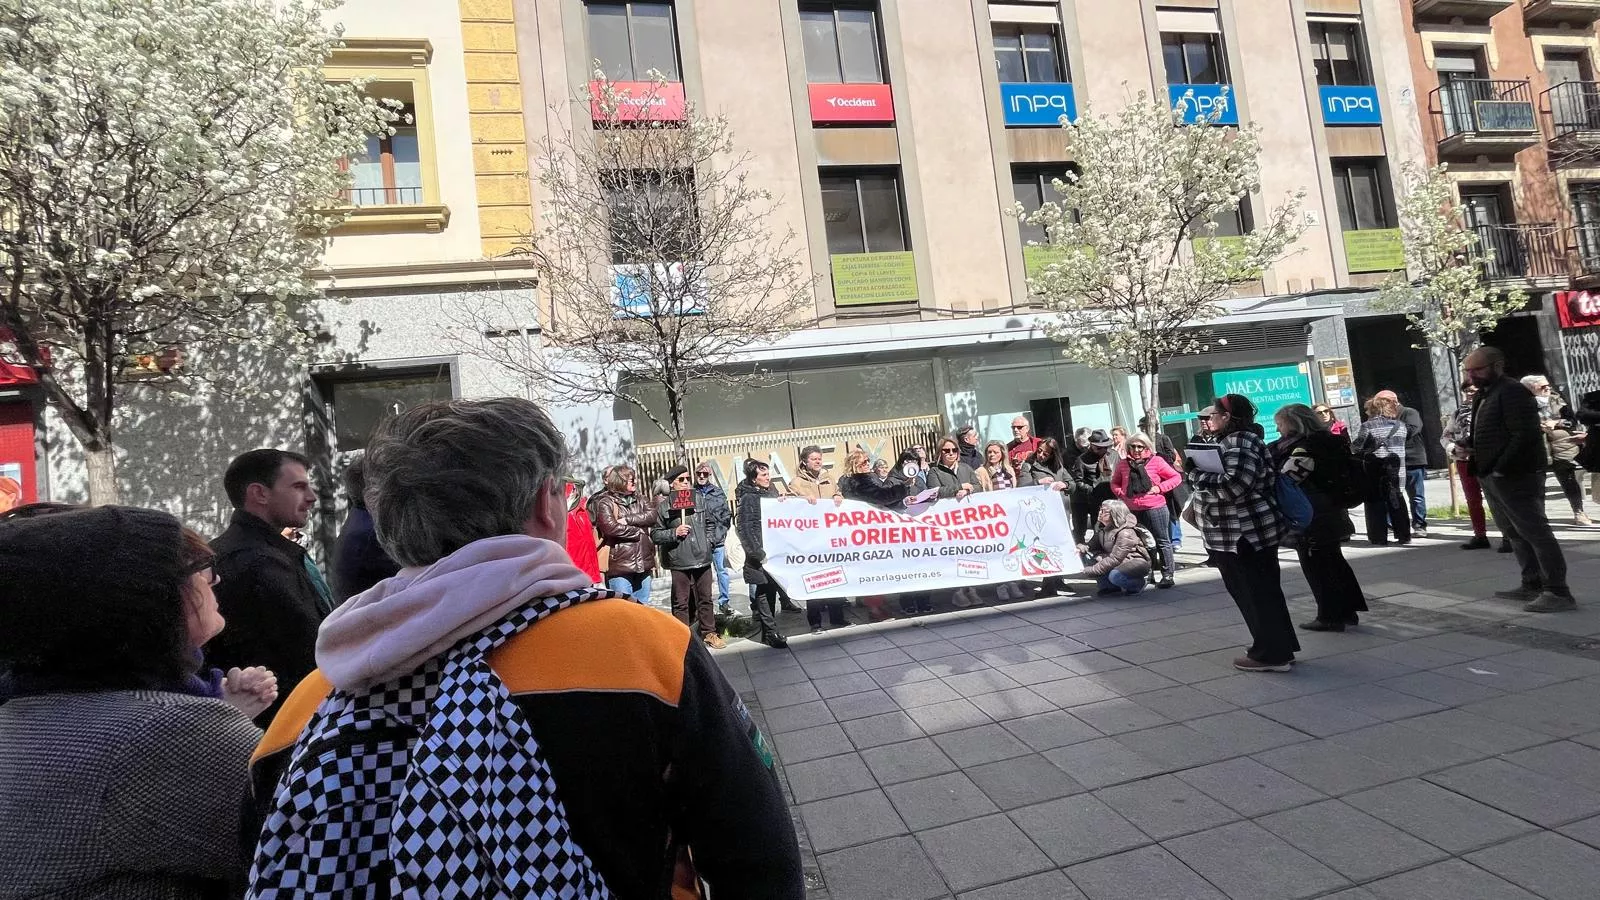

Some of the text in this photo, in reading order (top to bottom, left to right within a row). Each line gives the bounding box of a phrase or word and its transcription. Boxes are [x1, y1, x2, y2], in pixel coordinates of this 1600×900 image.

[837, 97, 877, 107] Occident
[1178, 95, 1229, 112] npq
[1225, 375, 1299, 396] MAEX DOTU
[1252, 392, 1302, 403] DENTAL INTEGRAL
[393, 403, 399, 415] 1
[678, 490, 691, 498] NO
[767, 518, 792, 529] HAY
[794, 518, 819, 531] QUE
[824, 510, 895, 528] PARAR
[921, 503, 1007, 527] GUERRA
[830, 521, 1009, 548] EN ORIENTE MEDIO
[786, 549, 894, 564] NO OLVIDAR GAZA
[902, 543, 1005, 558] NO AL GENOCIDIO
[859, 571, 942, 584] pararlaguerra.es
